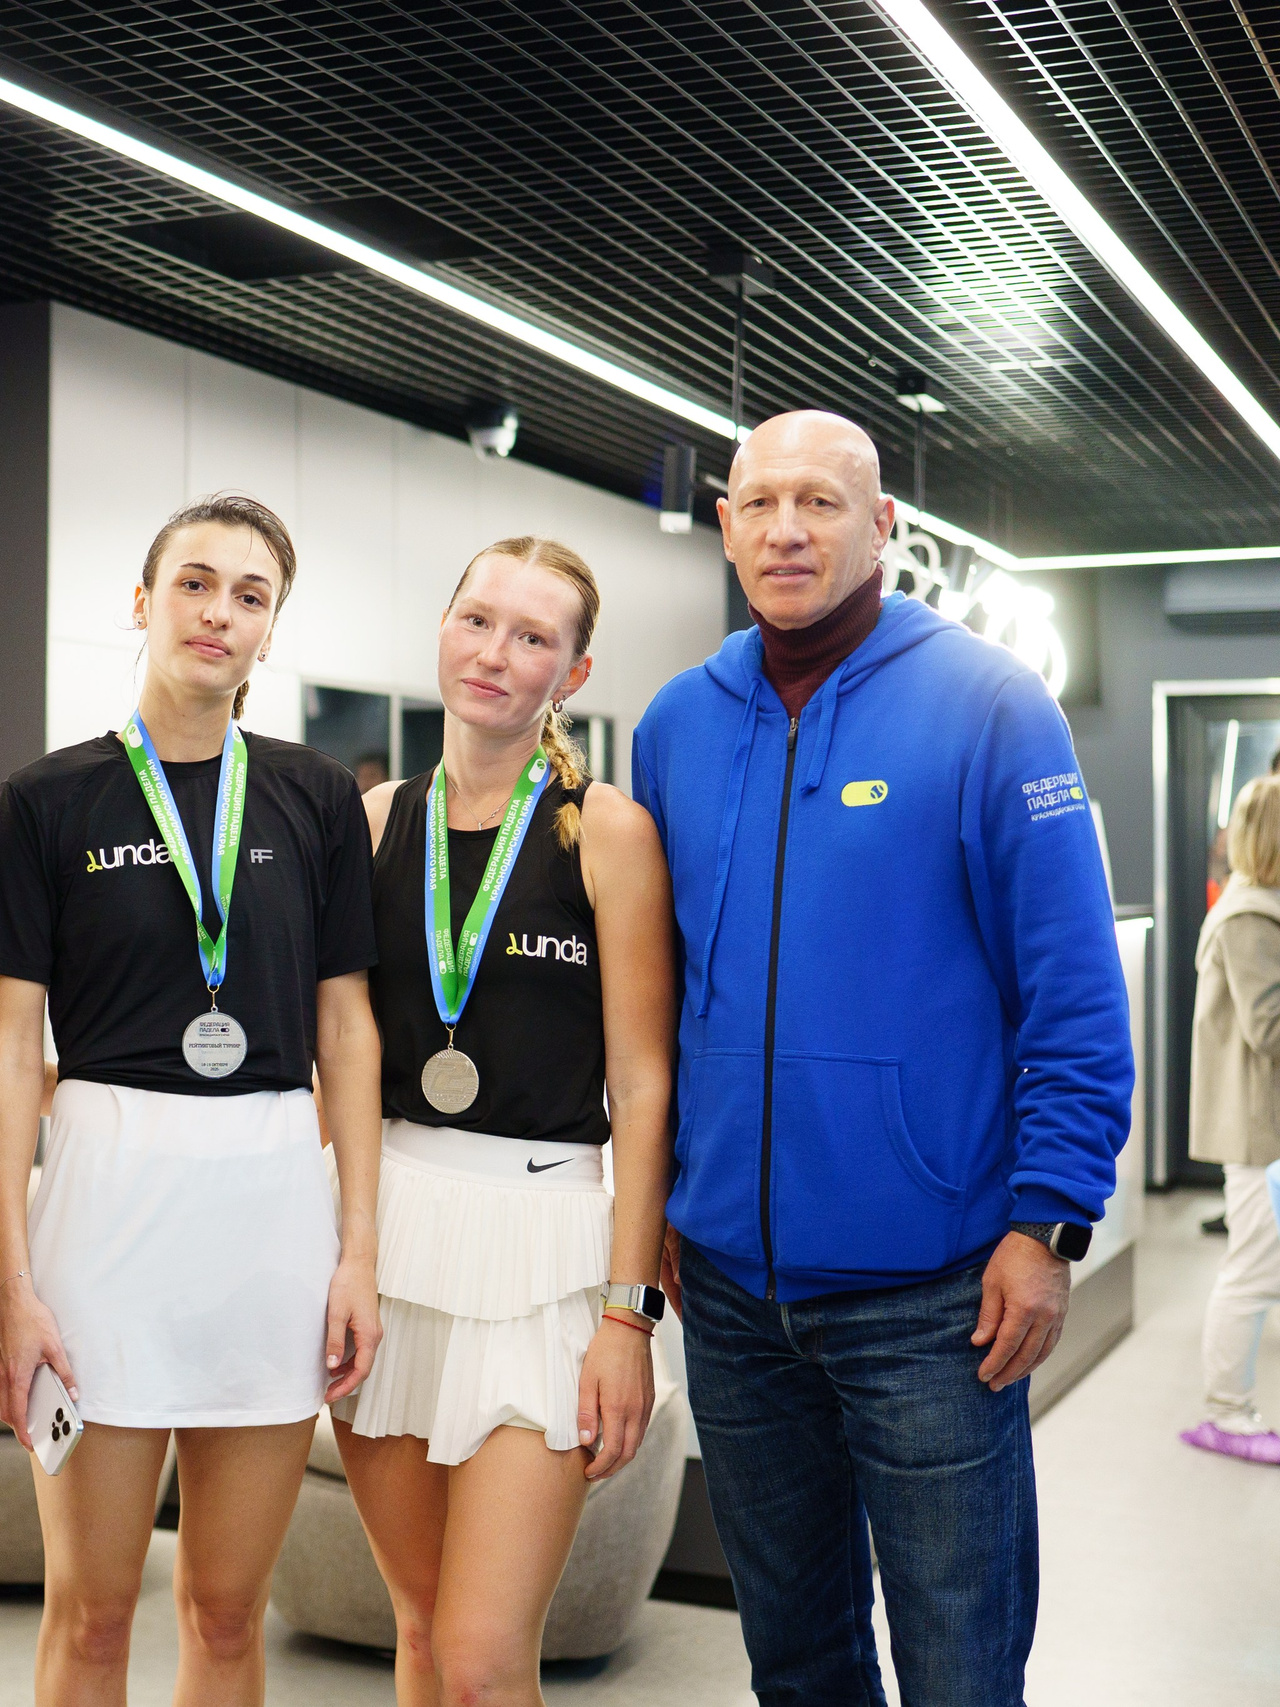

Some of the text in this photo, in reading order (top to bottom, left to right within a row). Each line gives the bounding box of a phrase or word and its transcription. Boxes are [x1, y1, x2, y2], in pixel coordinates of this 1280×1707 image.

[138, 769, 179, 857] ФЕДЕРАЦИЯ ПАДЕЛА
[146, 758, 191, 865] КРАСНОДАРСКОГО КРАЯ
[217, 751, 236, 856] КРАСНОДАРСКОГО КРАЯ
[228, 762, 245, 848] ФЕДЕРАЦИЯ ПАДЕЛА
[428, 788, 437, 891] КРАСНОДАРСКОГО КРАЯ
[437, 790, 447, 880] ФЕДЕРАЦИЯ ПАДЕЛА
[1026, 788, 1071, 811] ПАДЕЛА
[86, 838, 174, 873] Lunda
[482, 799, 521, 892] ФЕДЕРАЦИЯ ПАДЕЛА
[489, 794, 535, 902] КРАСНОДАРСКОГО КРАЯ
[435, 930, 445, 960] ПАДЕЛА
[443, 928, 455, 973] ФЕДЕРАЦИЯ
[463, 947, 474, 977] ПАДЕЛА
[505, 932, 587, 966] Lunda
